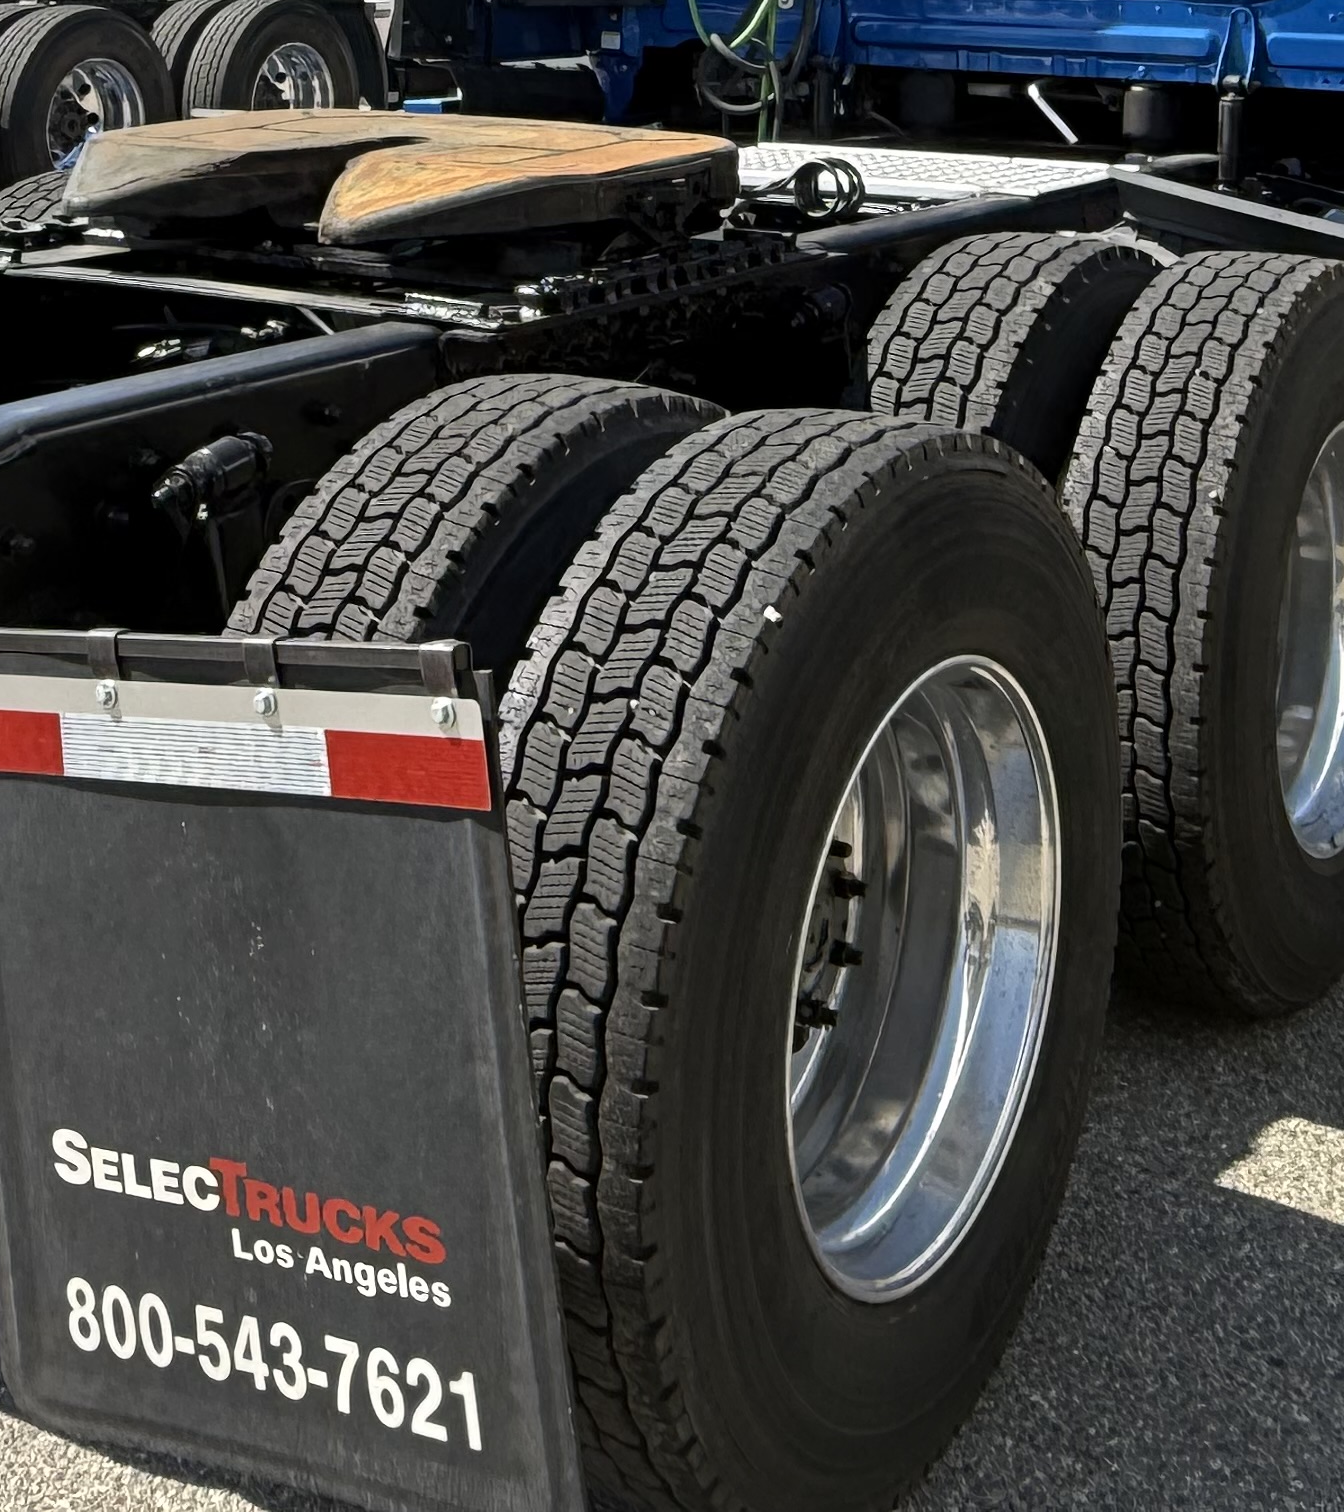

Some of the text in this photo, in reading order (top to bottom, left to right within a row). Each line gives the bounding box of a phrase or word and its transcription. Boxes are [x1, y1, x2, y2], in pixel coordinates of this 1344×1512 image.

[51, 1128, 448, 1265] SELECTRUCKS
[231, 1227, 452, 1308] Los Angeles
[66, 1276, 483, 1452] 800-543-7621
